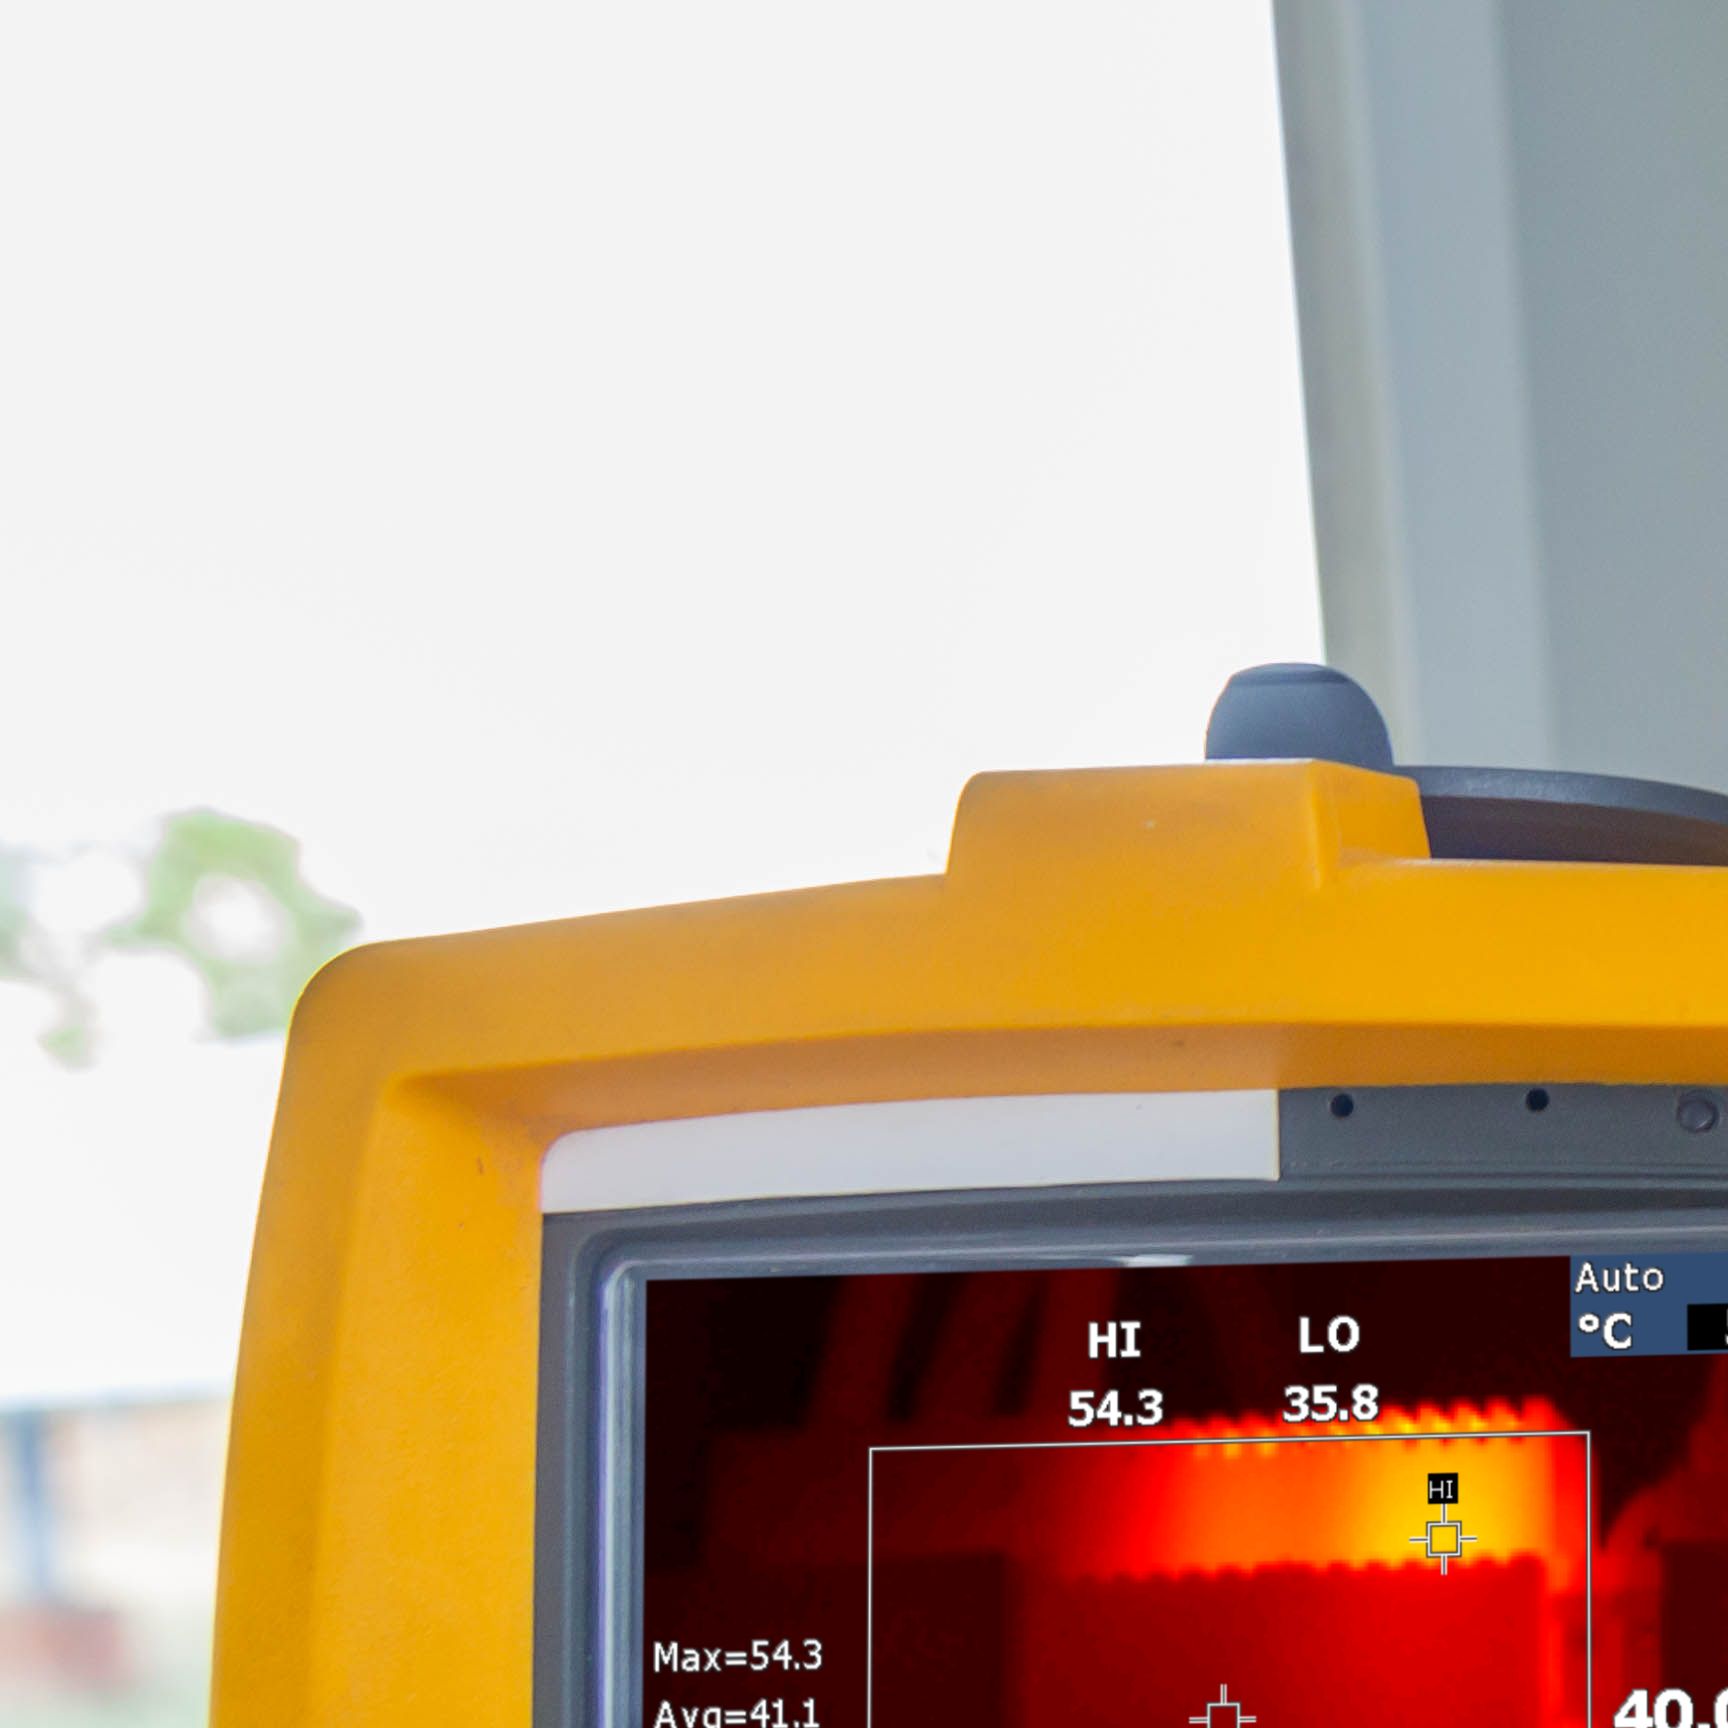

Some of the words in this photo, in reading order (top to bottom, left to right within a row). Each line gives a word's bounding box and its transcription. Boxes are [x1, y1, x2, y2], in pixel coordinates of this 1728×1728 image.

[1573, 1261, 1665, 1294] Auto
[1087, 1321, 1142, 1359] HI
[1298, 1315, 1361, 1354] LO
[1576, 1312, 1633, 1350] °C
[1067, 1388, 1164, 1427] 54.3
[1283, 1383, 1380, 1422] 35.8
[1428, 1479, 1455, 1500] HI
[653, 1638, 823, 1674] Max=54.3
